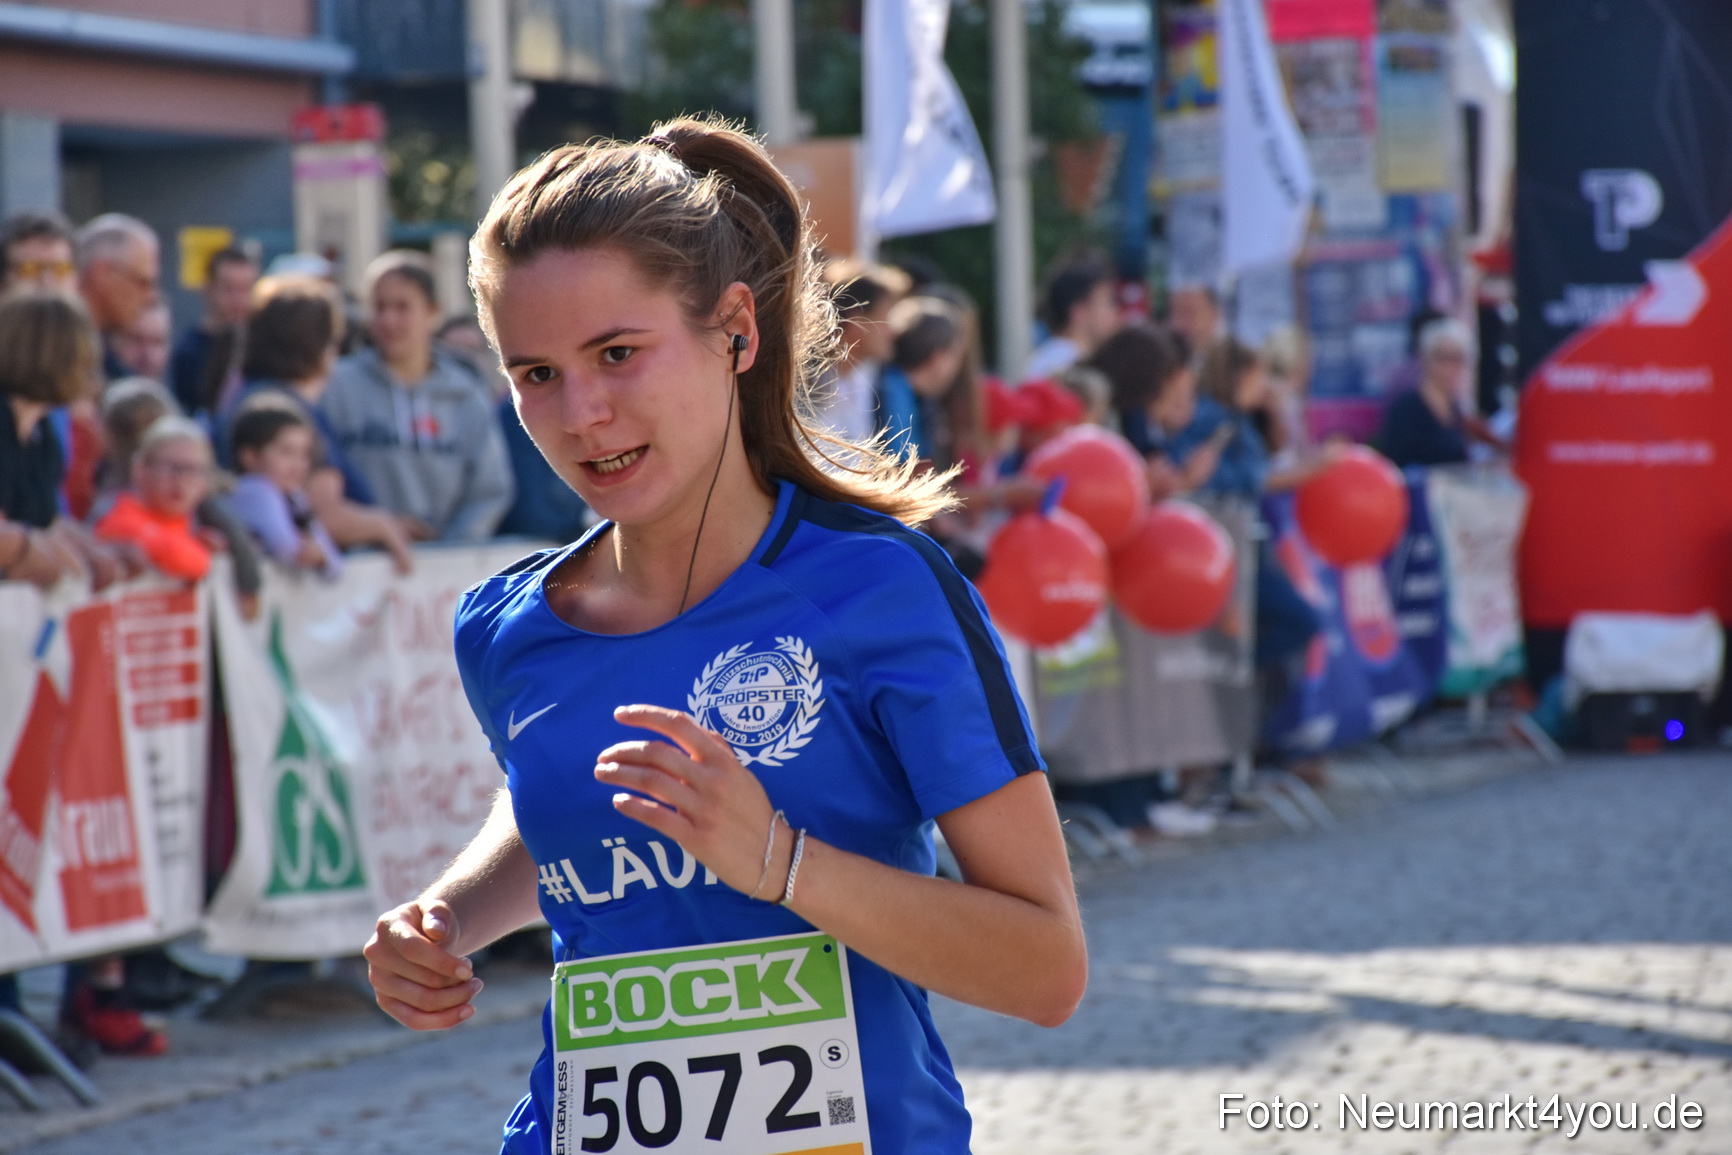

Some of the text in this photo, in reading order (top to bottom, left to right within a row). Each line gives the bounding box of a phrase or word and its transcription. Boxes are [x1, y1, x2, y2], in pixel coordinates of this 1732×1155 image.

[703, 687, 806, 709] J.PRÖPSTER
[722, 708, 782, 731] Jahre Innovation
[737, 705, 765, 722] 40
[722, 727, 747, 744] 1979
[758, 723, 784, 743] 2019
[571, 954, 812, 1034] BOCK
[828, 1046, 842, 1062] S
[556, 1061, 568, 1155] EITGEMAESS
[581, 1045, 822, 1154] 5072
